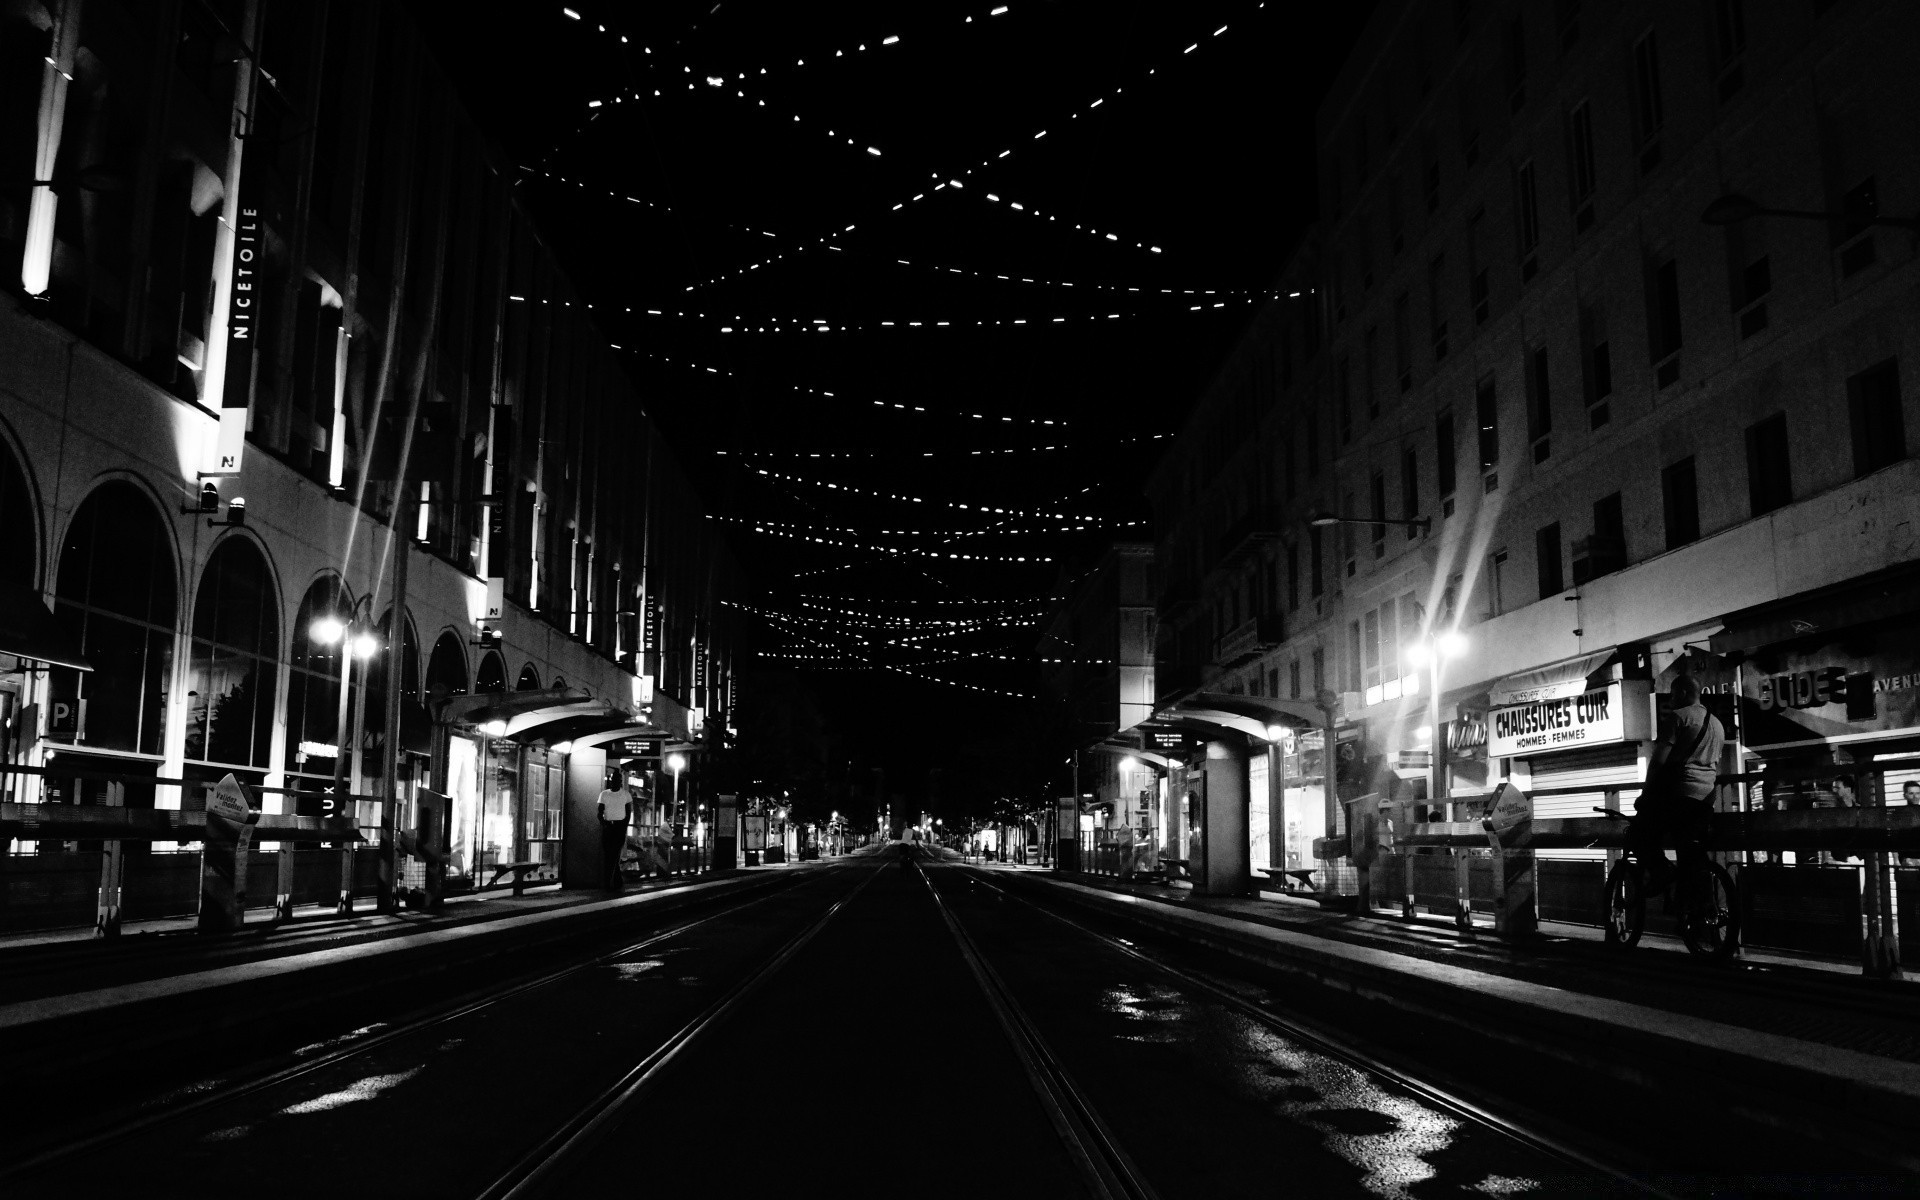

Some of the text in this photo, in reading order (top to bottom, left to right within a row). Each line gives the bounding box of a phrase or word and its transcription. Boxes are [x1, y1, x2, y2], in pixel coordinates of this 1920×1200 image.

[233, 207, 258, 339] NICETOILE
[645, 595, 654, 649] NICETOILE
[53, 702, 70, 727] P
[1496, 690, 1609, 739] CHAUSSURES CUIR
[1516, 728, 1586, 749] HOMMES FEMMES
[216, 791, 237, 804] Validez
